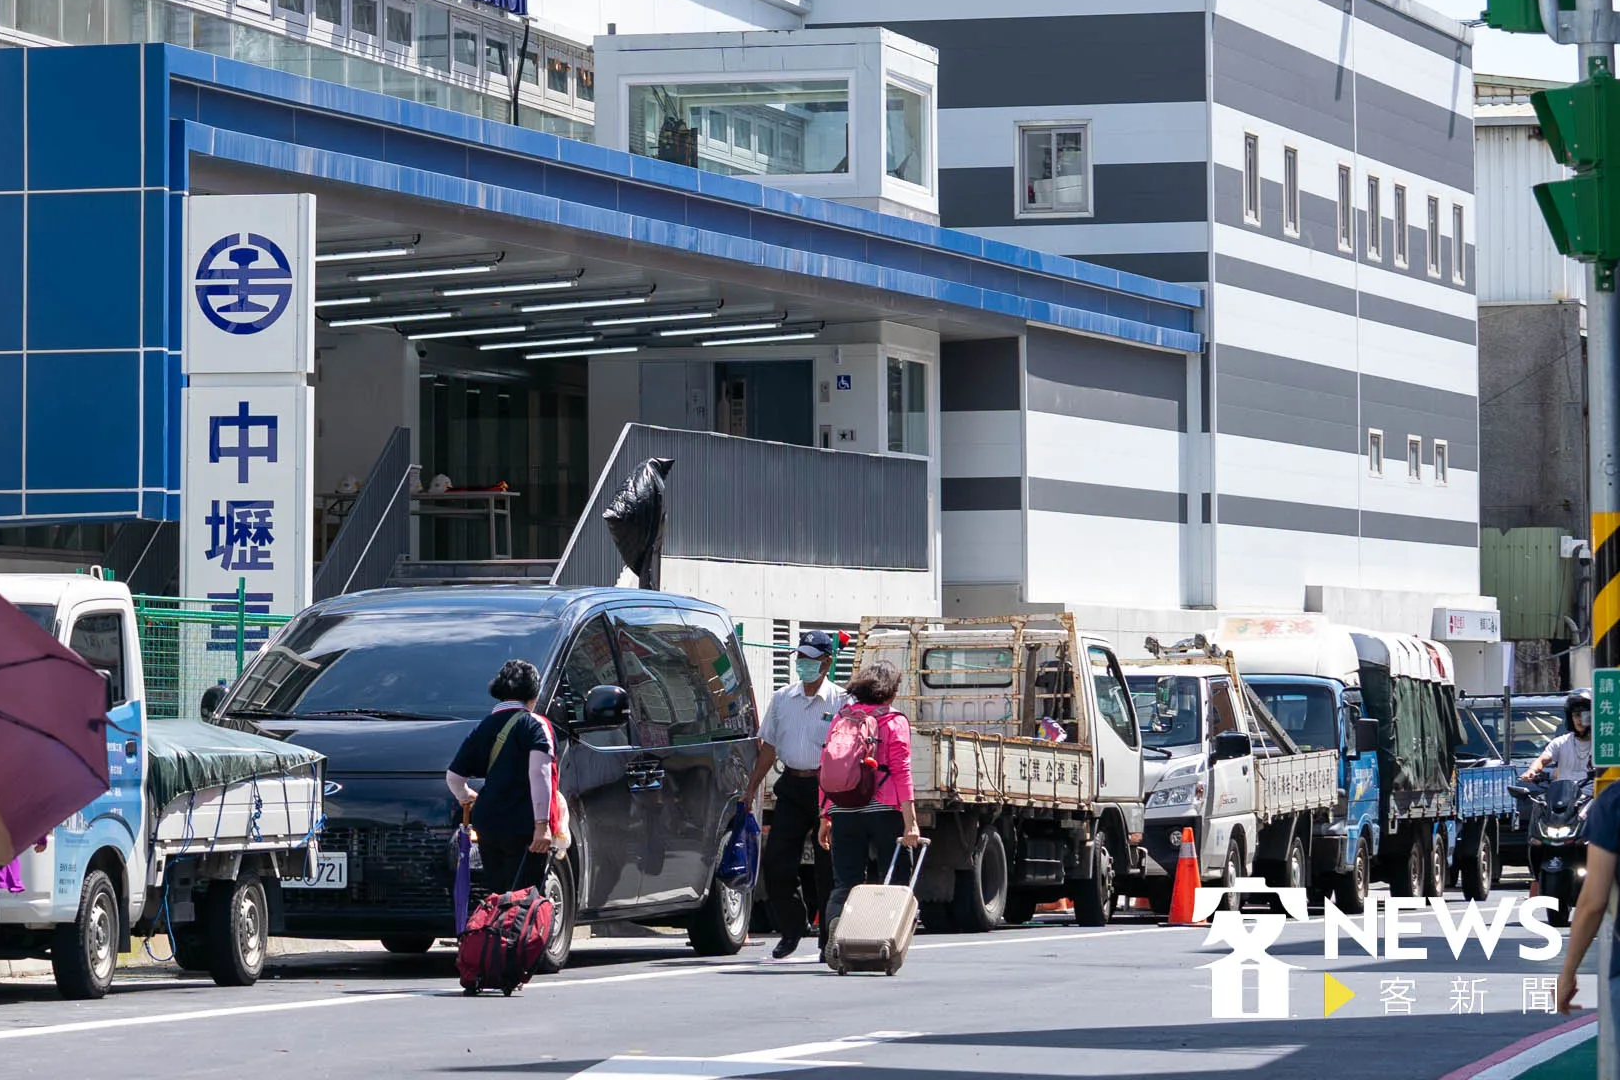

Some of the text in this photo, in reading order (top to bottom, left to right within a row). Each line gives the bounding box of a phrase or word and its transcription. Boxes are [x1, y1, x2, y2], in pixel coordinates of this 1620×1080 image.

[205, 401, 278, 686] 中壢車
[1599, 678, 1614, 758] 請先按鈕
